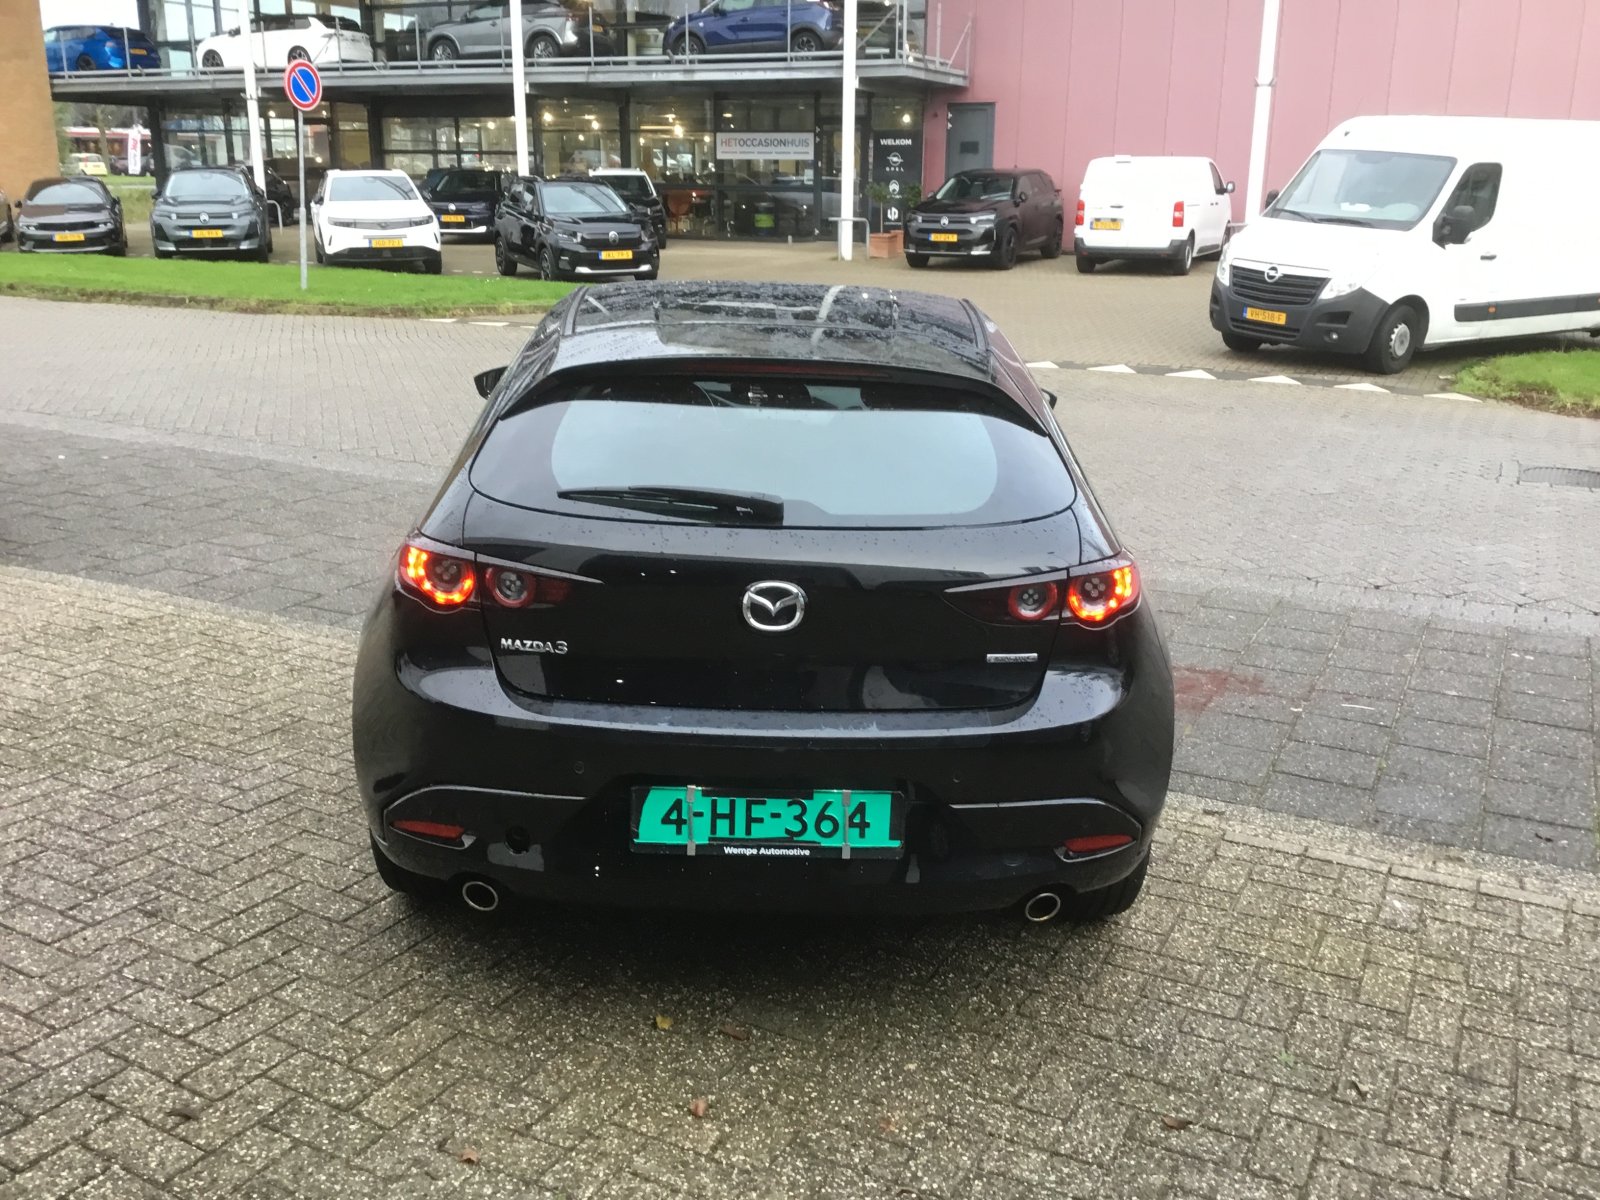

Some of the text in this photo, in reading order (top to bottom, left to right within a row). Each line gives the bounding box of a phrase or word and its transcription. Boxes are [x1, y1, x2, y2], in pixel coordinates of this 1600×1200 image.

[720, 137, 810, 148] HETOCCASIONHUIS
[879, 138, 912, 146] WELKOM
[1249, 309, 1283, 323] VH-518-F
[500, 637, 568, 655] MAZDA3
[660, 797, 871, 839] 4-HF-364
[723, 845, 811, 857] Wempe Automotive
